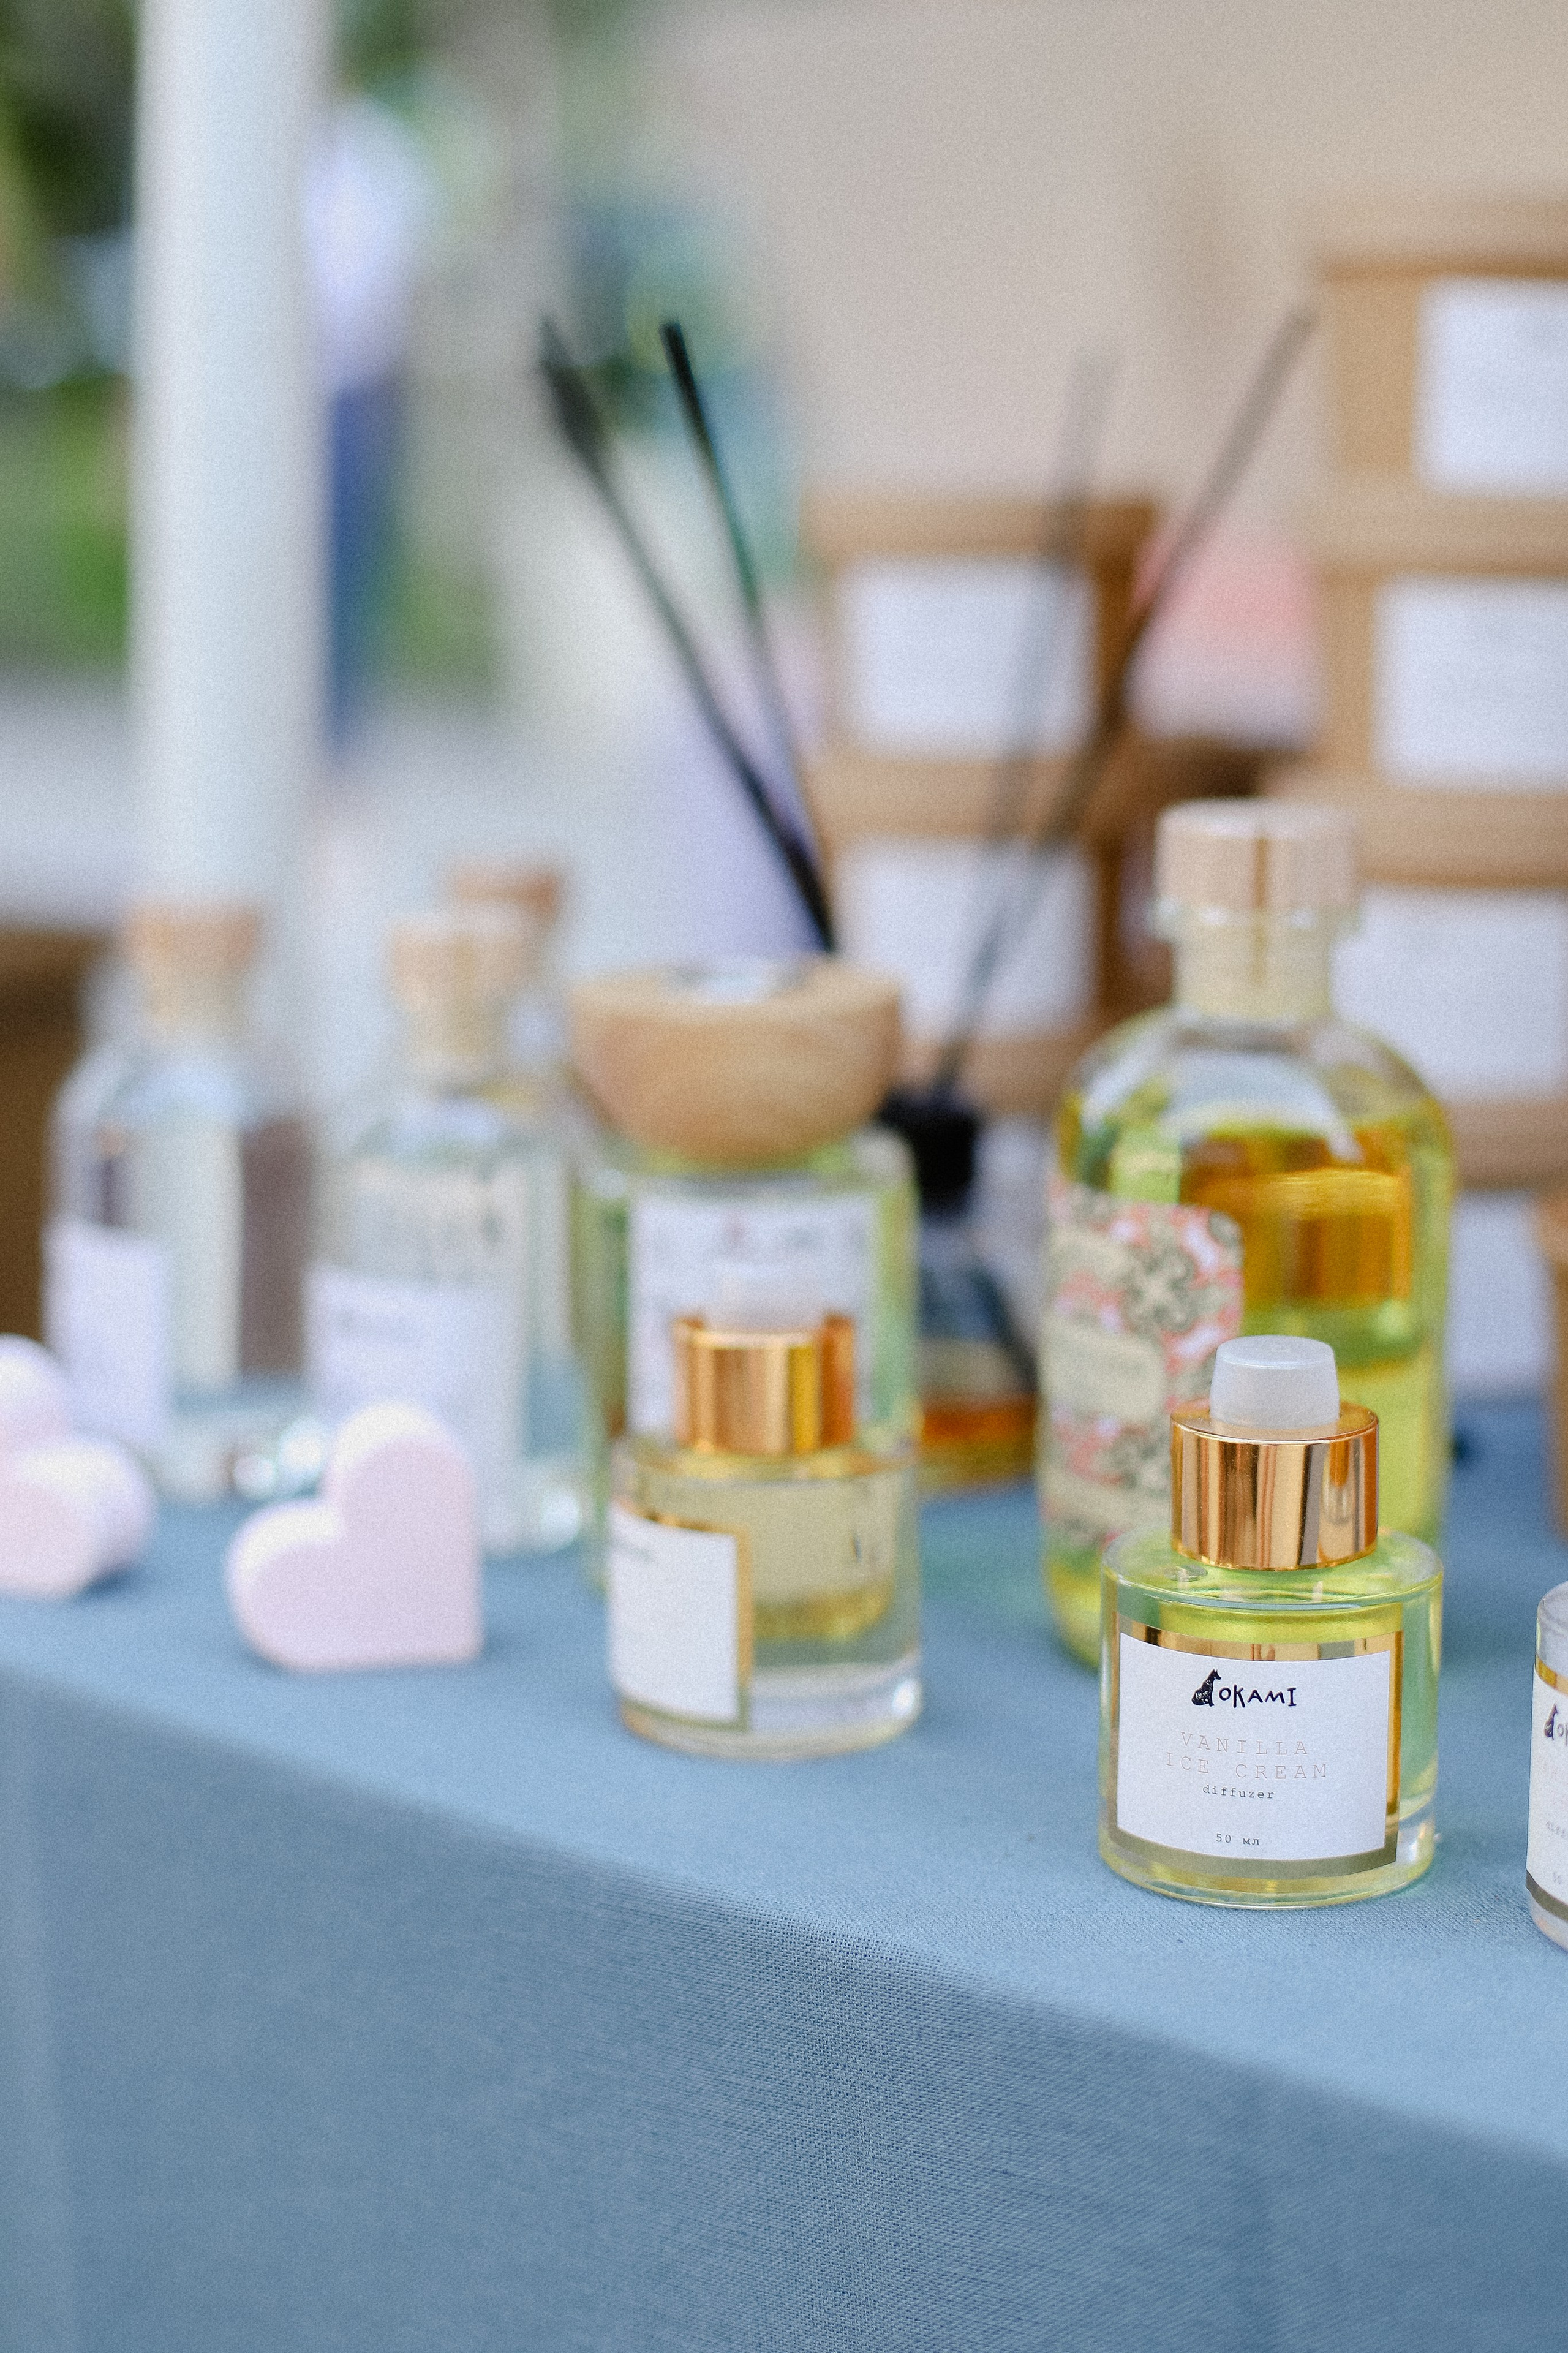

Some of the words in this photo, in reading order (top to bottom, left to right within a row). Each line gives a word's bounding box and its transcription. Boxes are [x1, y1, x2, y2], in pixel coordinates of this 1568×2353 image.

[1219, 1685, 1297, 1708] OKAMI
[1181, 1732, 1308, 1755] VANILLA
[1166, 1752, 1209, 1773] ICE
[1235, 1764, 1326, 1779] CREAM
[1203, 1785, 1275, 1798] diffuzer
[1216, 1833, 1231, 1843] 50
